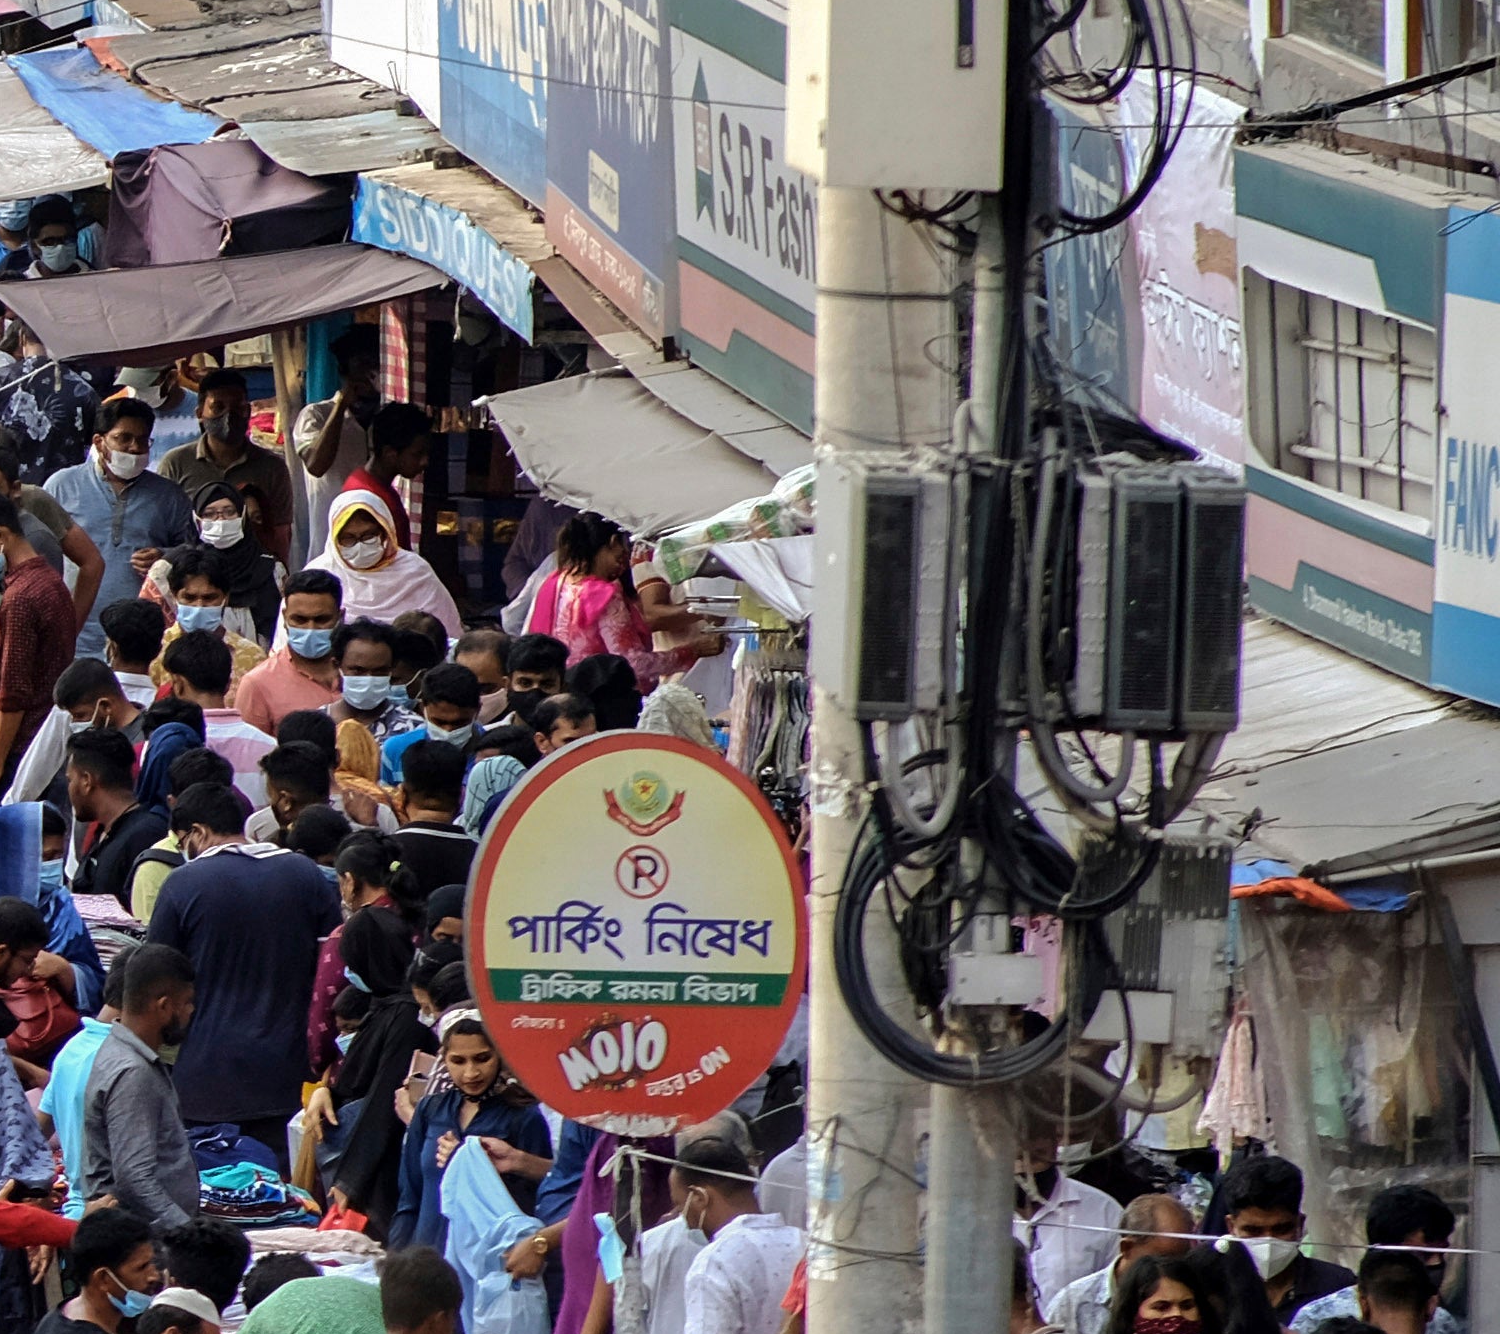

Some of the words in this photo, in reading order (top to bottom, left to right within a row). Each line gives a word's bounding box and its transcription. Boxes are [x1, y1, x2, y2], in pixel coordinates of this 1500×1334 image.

[761, 135, 818, 284] Fash
[507, 900, 626, 960] পার্কিং
[644, 901, 772, 959] নিষেধ
[520, 973, 603, 1002] ট্রাফিক
[609, 979, 676, 1002] রমনা
[683, 974, 759, 1003] বিভাগ
[558, 1021, 668, 1092] MOJO
